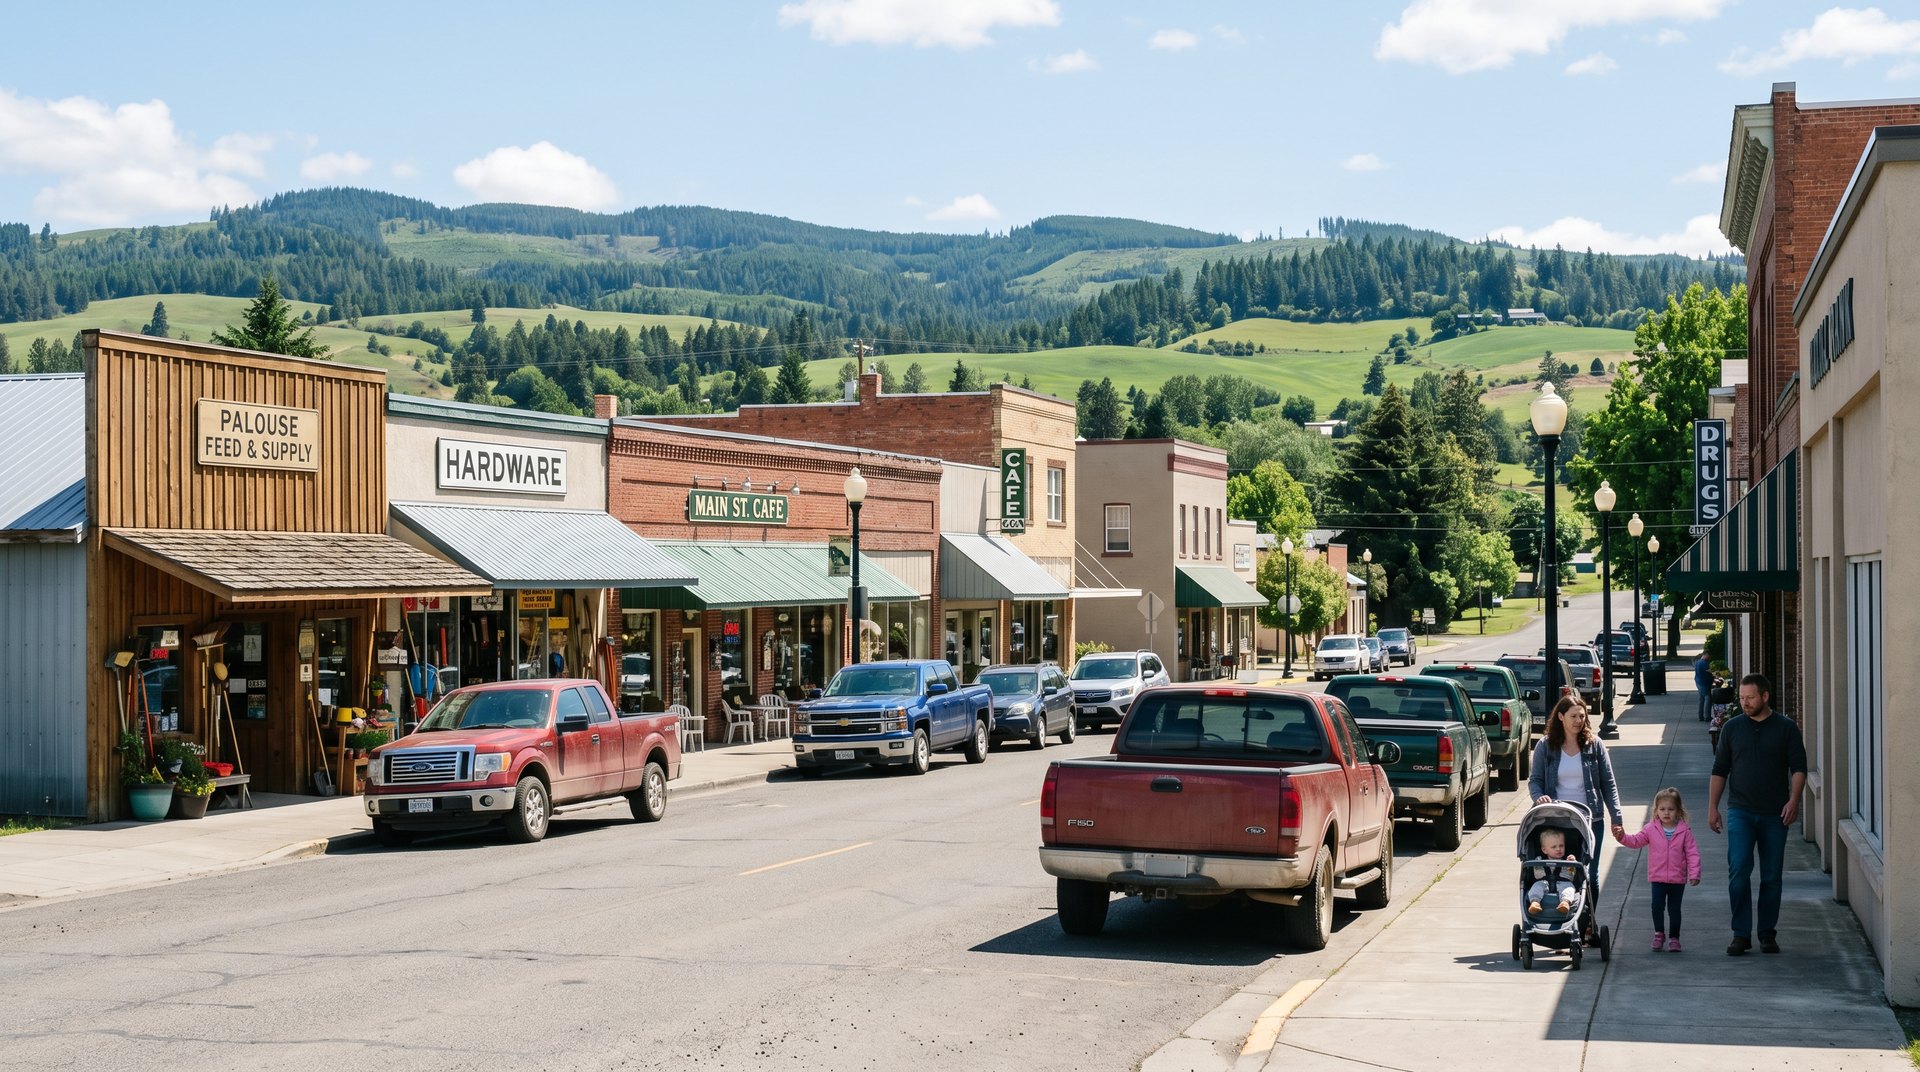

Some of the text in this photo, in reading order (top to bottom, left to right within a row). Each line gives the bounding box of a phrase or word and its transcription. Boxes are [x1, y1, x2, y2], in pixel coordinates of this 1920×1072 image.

[221, 409, 299, 438] PALOUSE
[206, 436, 312, 463] FEED & SUPPLY
[446, 448, 562, 486] HARDWARE
[1701, 426, 1720, 519] DRUGS
[1005, 452, 1022, 516] CAFE
[695, 495, 784, 519] MAIN ST. CAFE
